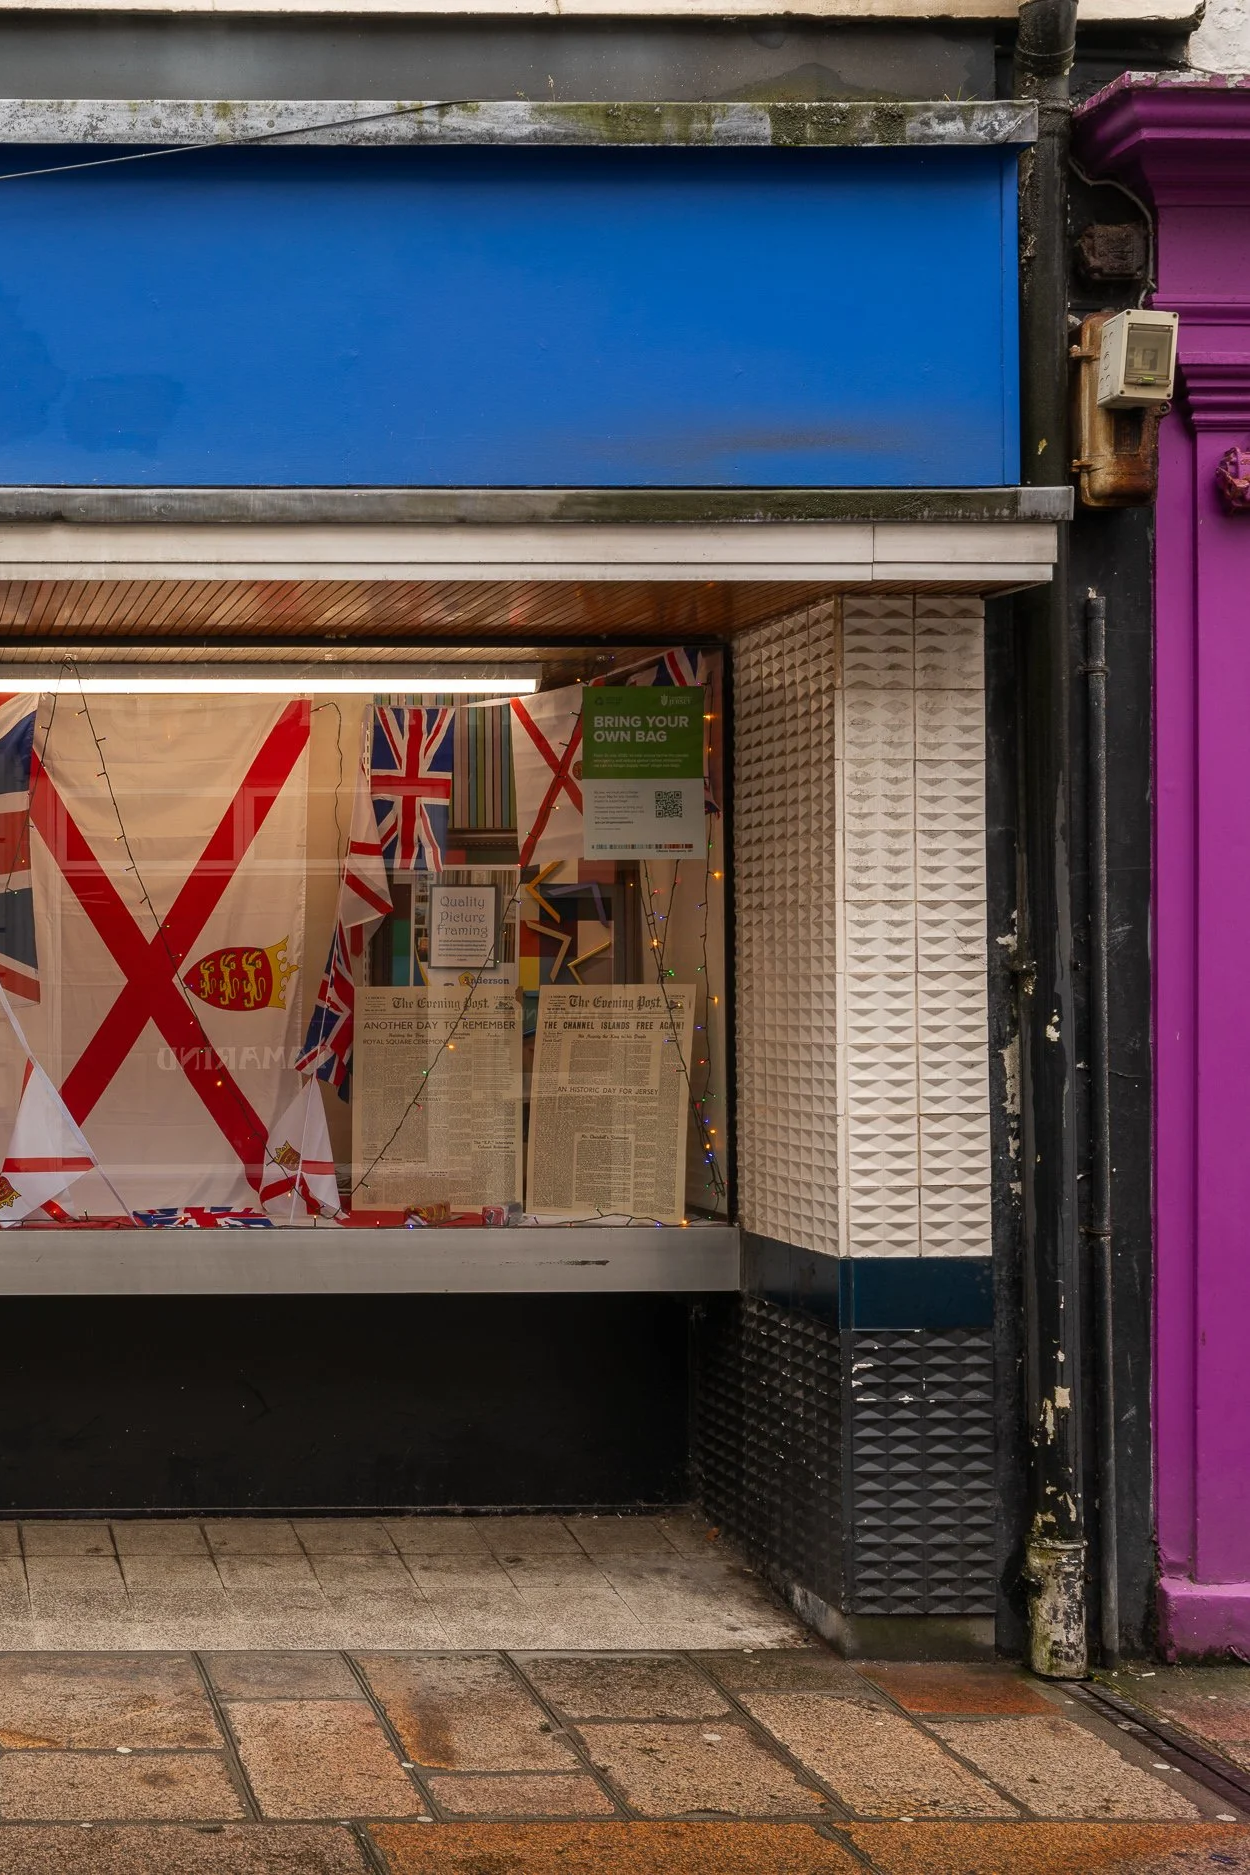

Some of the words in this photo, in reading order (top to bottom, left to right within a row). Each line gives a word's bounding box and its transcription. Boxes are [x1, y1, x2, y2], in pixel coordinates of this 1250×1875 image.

[593, 715, 642, 728] BRING
[645, 715, 690, 728] YOUR
[593, 730, 631, 743] OWN
[635, 730, 668, 742] BAG
[439, 896, 485, 910] Quality
[438, 911, 486, 924] Picture
[437, 924, 488, 938] Framing
[391, 997, 414, 1009] The
[417, 997, 461, 1012] Evening
[569, 994, 590, 1009] The
[593, 995, 634, 1011] Evening
[637, 996, 662, 1011] Post.
[363, 1021, 416, 1030] ANOTHER
[416, 1021, 438, 1030] DAY
[443, 1021, 458, 1030] TO
[462, 1021, 516, 1030] REMEMBER
[544, 1021, 558, 1030] THE
[563, 1021, 595, 1030] CHANNEL
[600, 1021, 630, 1030] ISLANDS
[636, 1021, 654, 1030] FREE
[569, 1086, 600, 1094] HISTORIC
[619, 1087, 632, 1095] FOR
